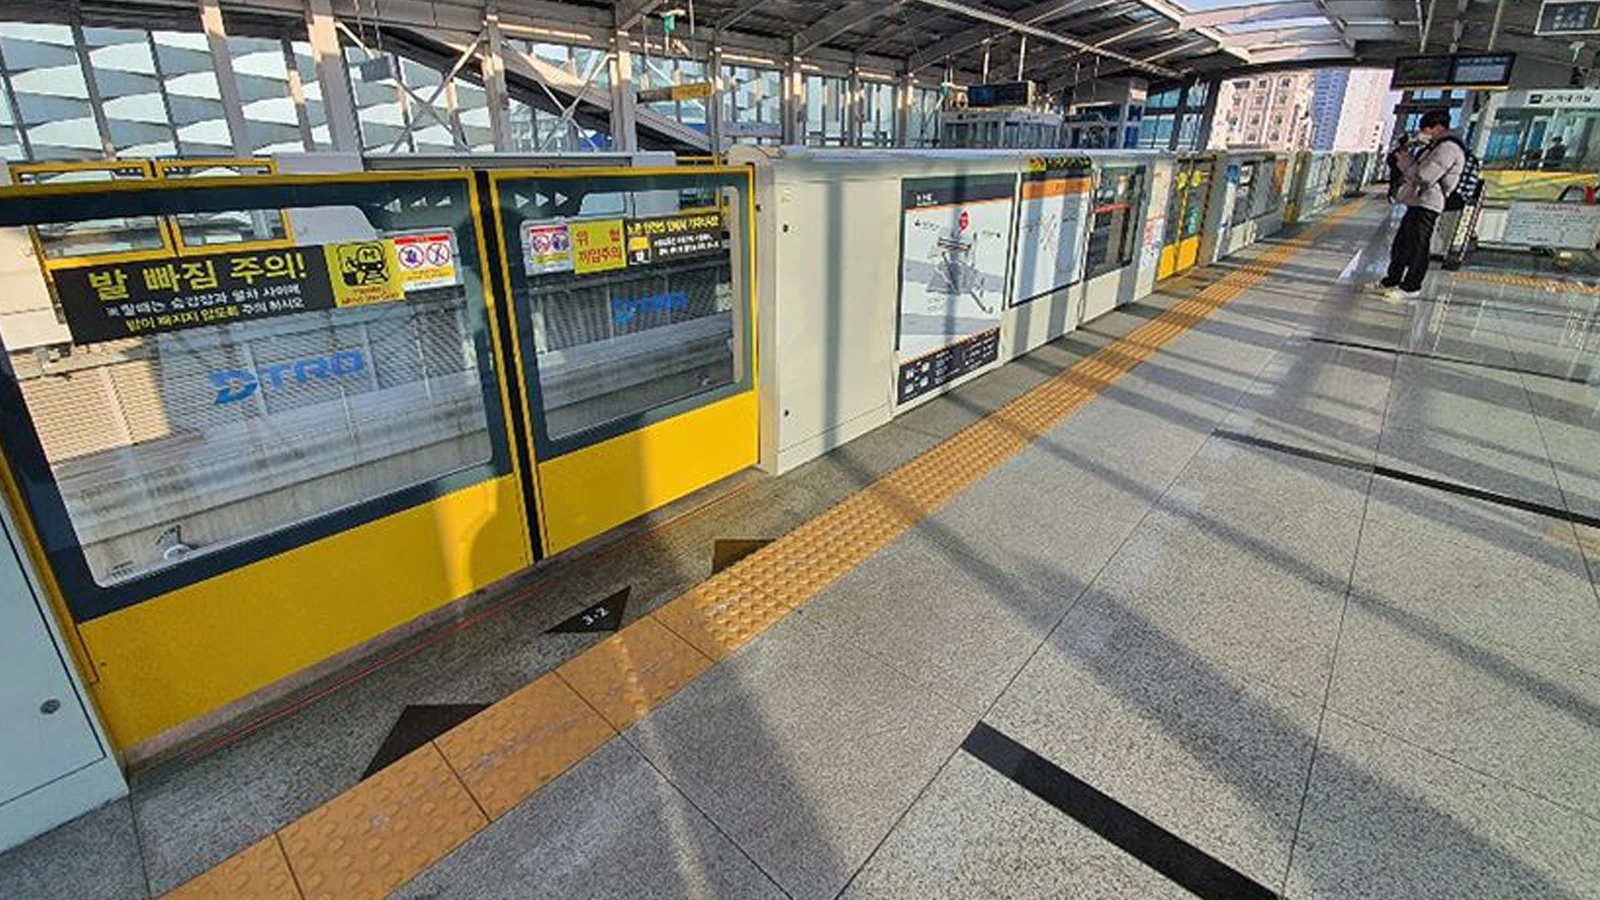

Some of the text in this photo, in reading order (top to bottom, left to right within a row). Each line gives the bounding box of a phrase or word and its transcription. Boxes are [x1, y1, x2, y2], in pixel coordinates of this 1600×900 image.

[89, 252, 306, 300] 발 빠짐 주의!
[231, 288, 259, 303] 열차
[262, 283, 302, 298] 사이에
